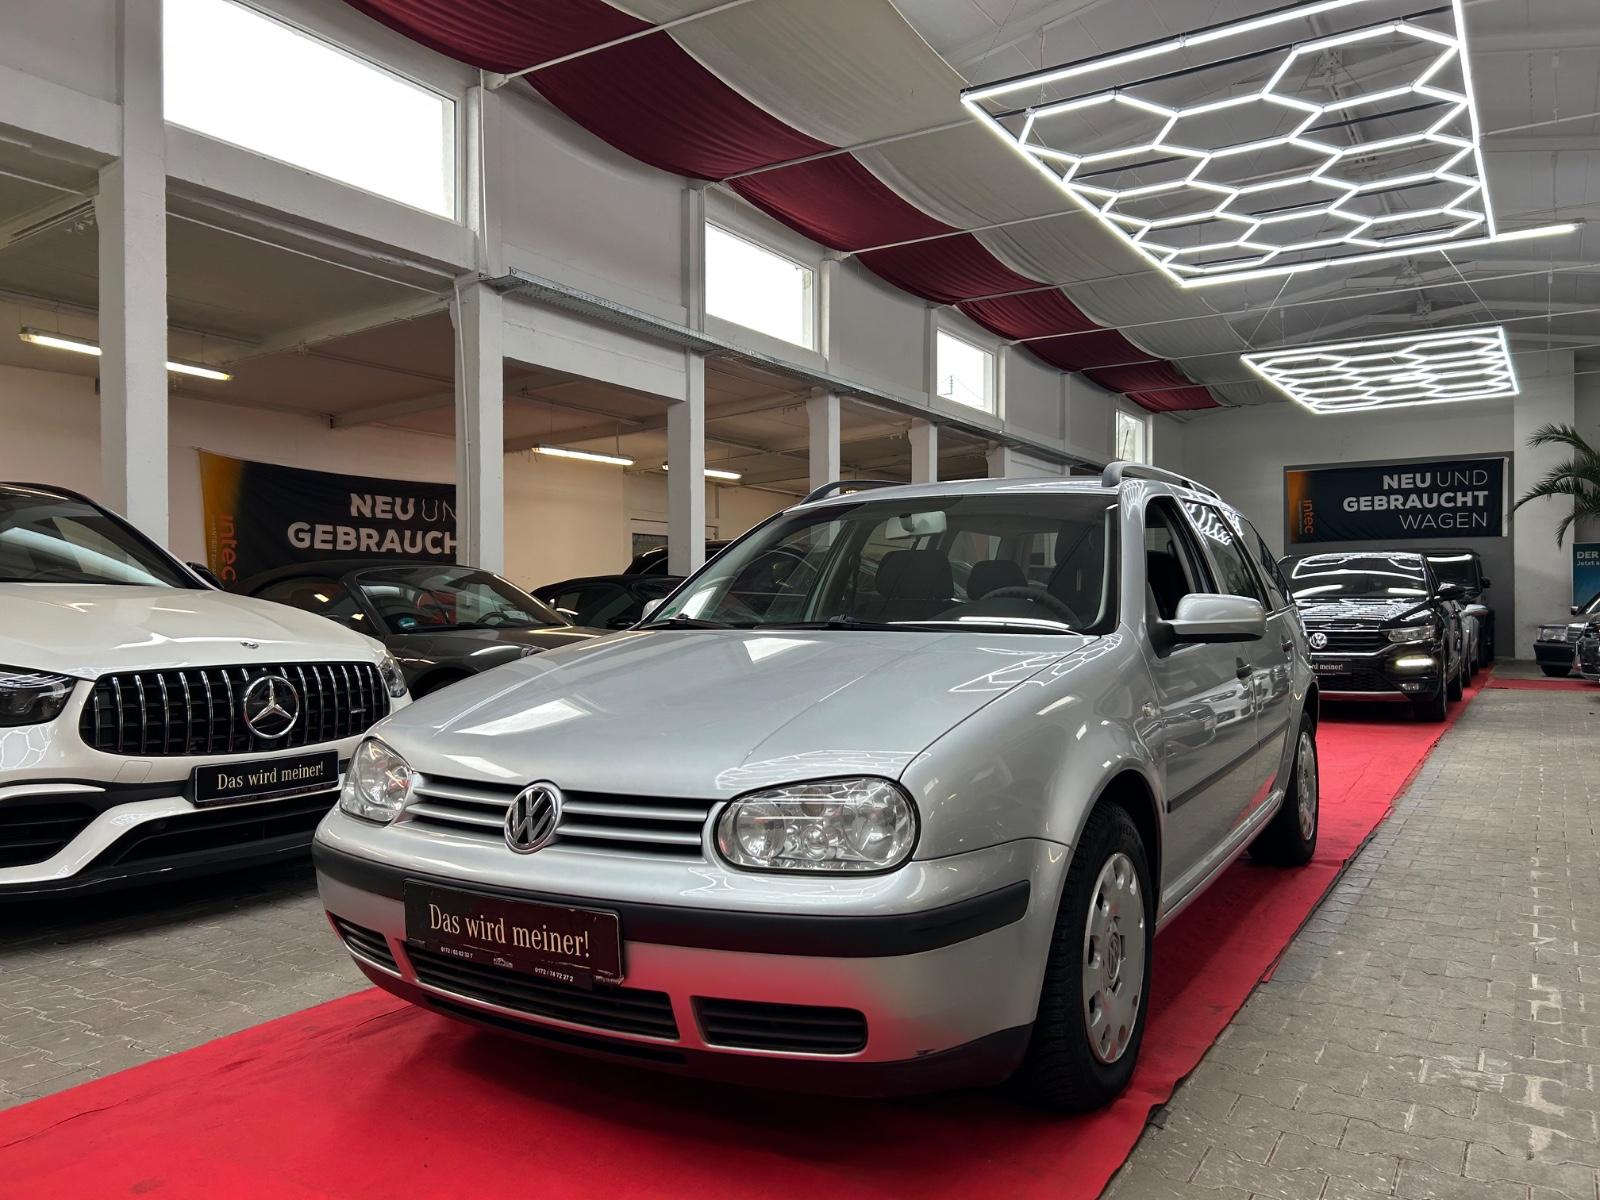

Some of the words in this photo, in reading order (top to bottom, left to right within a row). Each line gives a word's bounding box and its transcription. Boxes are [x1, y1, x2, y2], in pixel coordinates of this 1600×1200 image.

[1383, 472, 1431, 489] NEU
[1437, 469, 1488, 487] UND
[350, 493, 415, 520] NEU
[421, 498, 456, 522] UN
[1342, 490, 1489, 513] GEBRAUCHT
[1303, 499, 1313, 534] intec
[1399, 512, 1487, 530] WAGEN
[220, 513, 238, 583] intec
[287, 521, 456, 555] GEBRAUCH
[1576, 551, 1599, 559] DER
[217, 773, 243, 790] Das
[248, 767, 277, 786] wird
[281, 761, 324, 782] meiner!
[429, 903, 460, 935] Das
[464, 914, 506, 944] wird
[512, 924, 590, 958] meiner!
[534, 967, 546, 975] 0172
